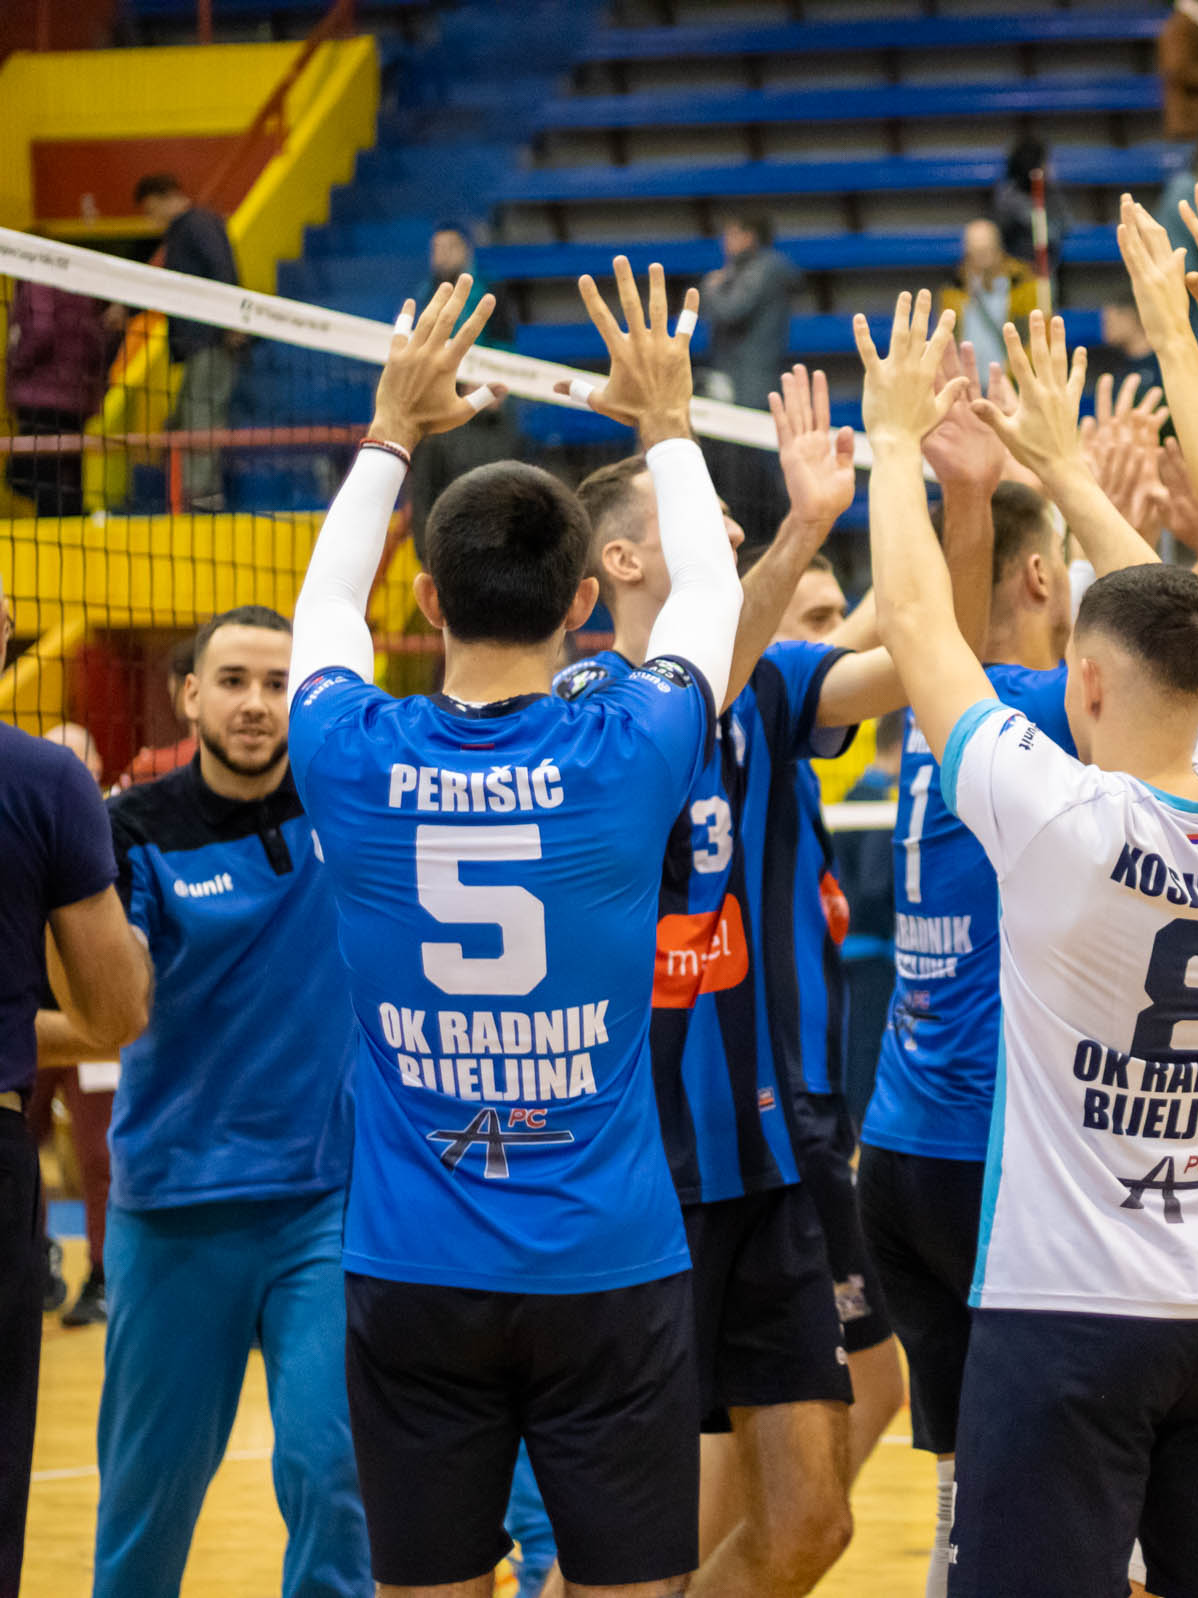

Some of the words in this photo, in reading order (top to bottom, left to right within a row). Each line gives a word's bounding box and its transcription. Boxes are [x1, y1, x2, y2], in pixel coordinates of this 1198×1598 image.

[389, 759, 564, 812] PERIŠIĆ
[691, 796, 733, 874] 3
[188, 872, 233, 897] unit
[415, 823, 547, 996] 5
[378, 1002, 432, 1054] OK
[437, 1000, 610, 1055] RADNIK
[397, 1052, 597, 1101] BIJELJINA
[1073, 1039, 1130, 1090] OK
[508, 1108, 548, 1129] PC
